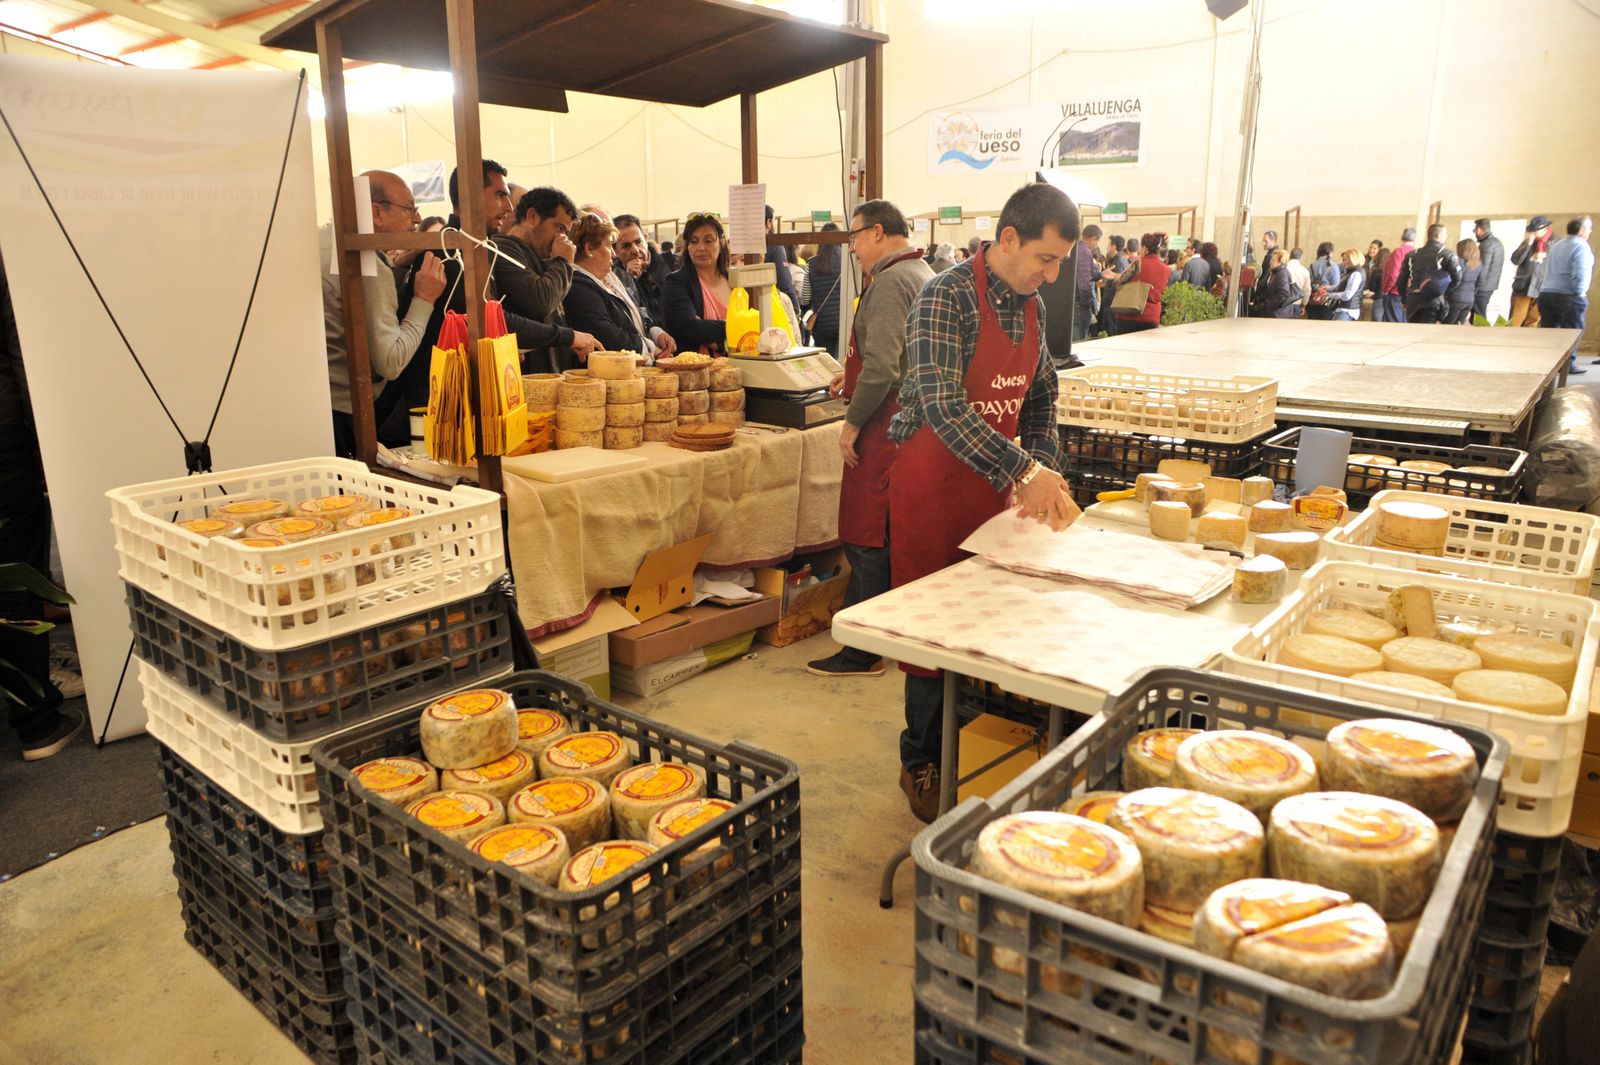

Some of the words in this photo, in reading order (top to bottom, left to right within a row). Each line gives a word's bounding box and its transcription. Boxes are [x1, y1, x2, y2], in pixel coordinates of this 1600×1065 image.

[1061, 98, 1142, 117] VILLALUENGA
[980, 130, 1003, 141] feria
[1005, 128, 1022, 139] del
[991, 374, 1027, 390] Queso
